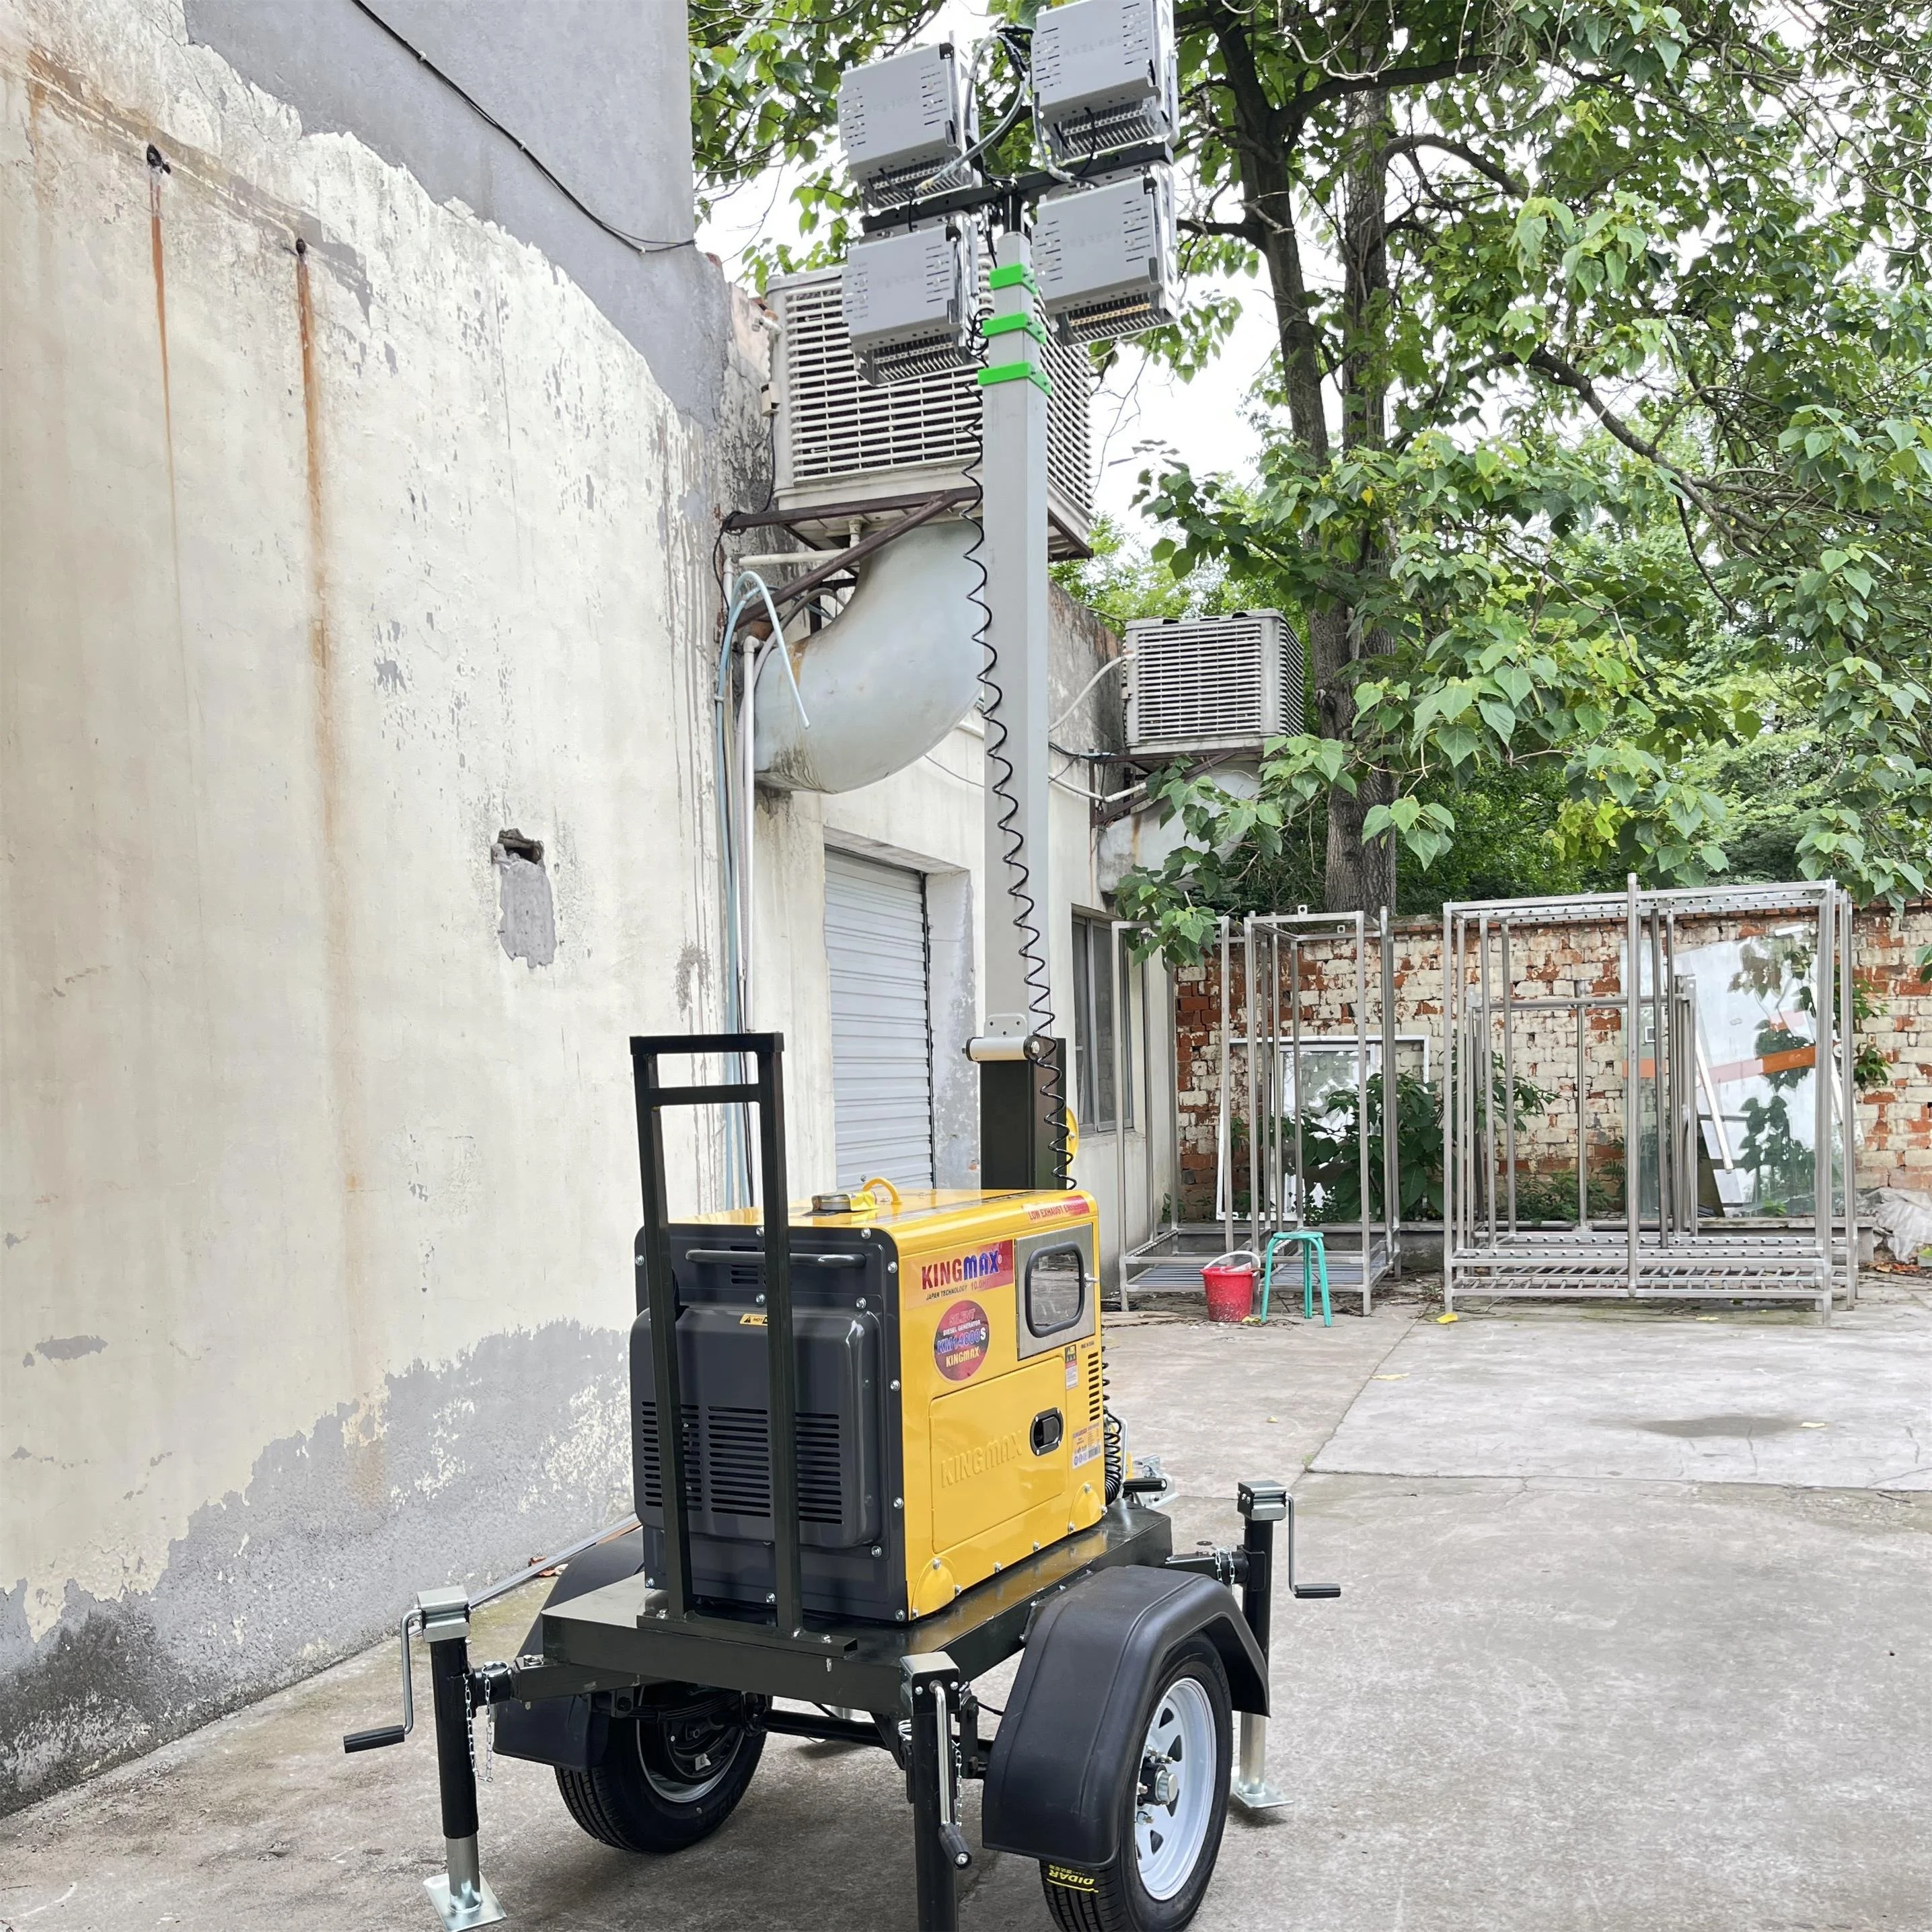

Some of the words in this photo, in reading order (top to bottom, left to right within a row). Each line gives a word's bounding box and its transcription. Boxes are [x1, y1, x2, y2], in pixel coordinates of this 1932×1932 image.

[1028, 1210, 1040, 1220] LOW
[1040, 1205, 1064, 1218] EXHAUST
[926, 1292, 940, 1300] JAPAN
[940, 1285, 967, 1297] TECHNOLOGY
[949, 1308, 975, 1326] SILENT
[943, 1326, 957, 1336] DIESEL
[957, 1319, 981, 1331] GENERATOR
[1048, 1869, 1095, 1885] DIDAR
